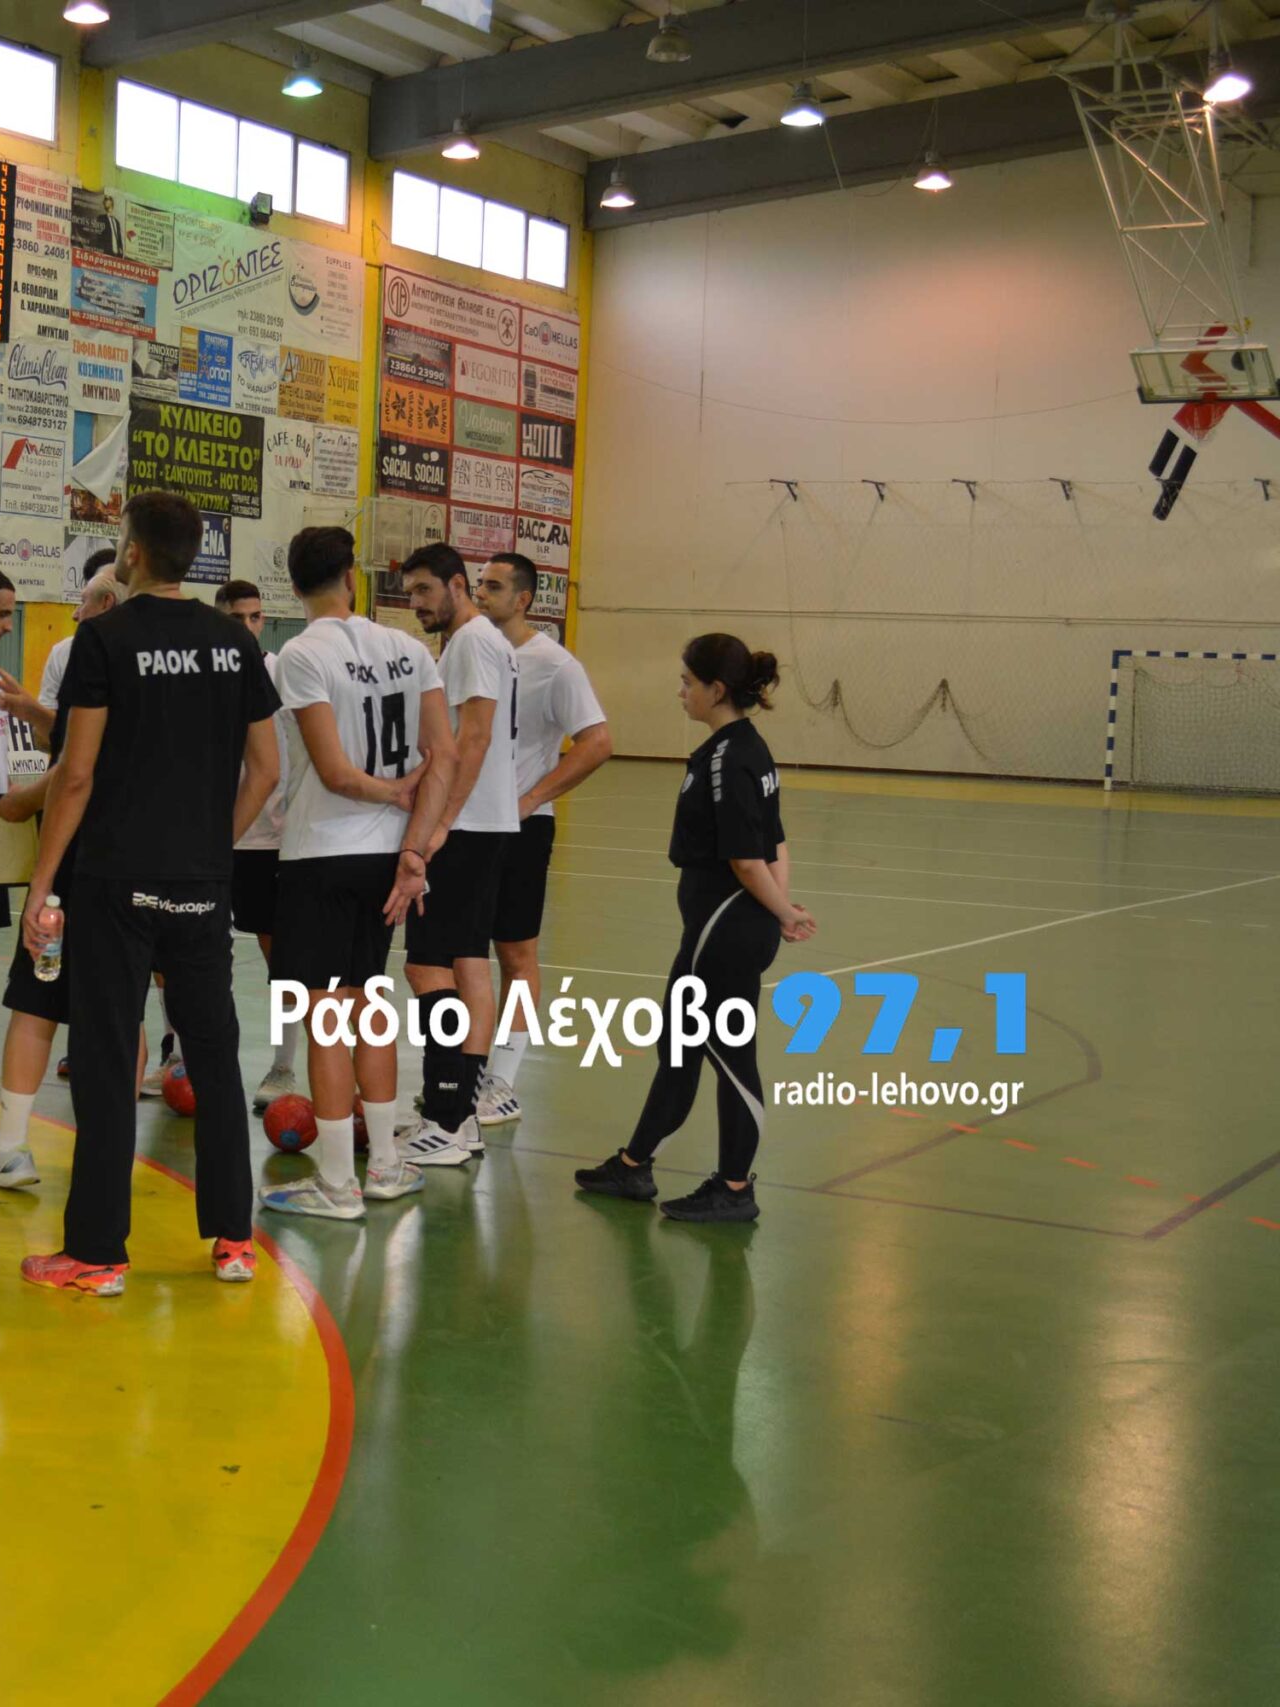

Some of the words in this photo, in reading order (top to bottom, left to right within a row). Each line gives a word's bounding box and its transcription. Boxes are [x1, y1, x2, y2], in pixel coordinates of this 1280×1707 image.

[0, 178, 8, 192] 5
[0, 194, 6, 207] 6
[0, 208, 6, 222] 7
[36, 324, 70, 342] ΑΜΥΝΤΑΙΟ
[524, 323, 538, 338] CaO
[552, 330, 578, 350] HELLAS
[148, 342, 180, 359] ΗΝΙΟΧΟΣ
[390, 360, 417, 374] 23860
[418, 366, 445, 382] 23990
[82, 383, 121, 403] ΑΜΥΝΤΑΙΟ
[17, 414, 68, 431] 6948753127
[158, 404, 242, 440] ΚΥΛΙΚΕΙΟ
[266, 431, 288, 452] CAFE
[132, 459, 158, 480] ΤΟΣΤ
[219, 472, 240, 490] HOT
[241, 476, 258, 493] DOG
[382, 456, 412, 481] SOCIAL
[414, 464, 446, 486] SOCIAL
[495, 464, 514, 480] CAN
[32, 545, 61, 559] HELLAS
[136, 649, 201, 677] PAOK
[212, 648, 242, 673] HC
[386, 656, 414, 681] HC
[362, 692, 410, 780] 14
[12, 758, 46, 772] ΑΜΥΝΤΑΙΟ
